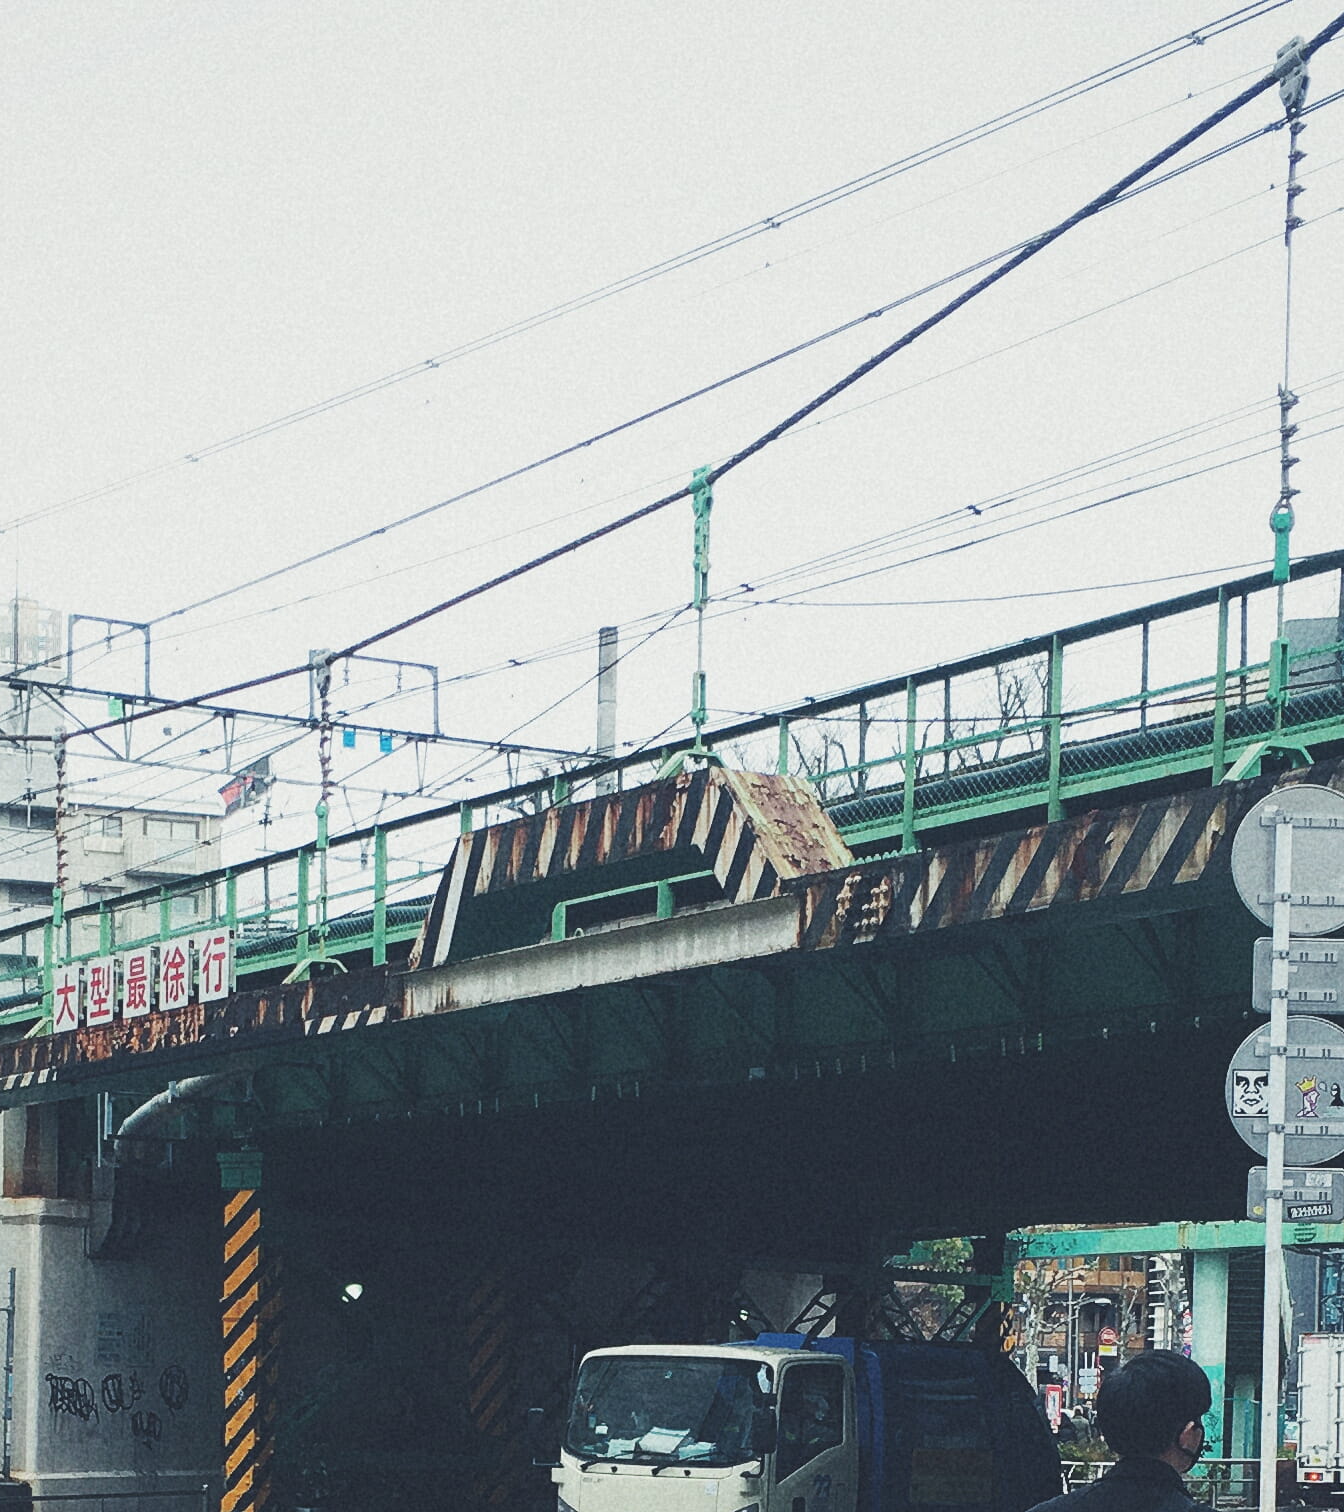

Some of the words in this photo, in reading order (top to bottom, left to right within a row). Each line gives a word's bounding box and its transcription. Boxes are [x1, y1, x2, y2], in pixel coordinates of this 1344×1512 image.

[55, 936, 226, 1026] 大型最徐行
